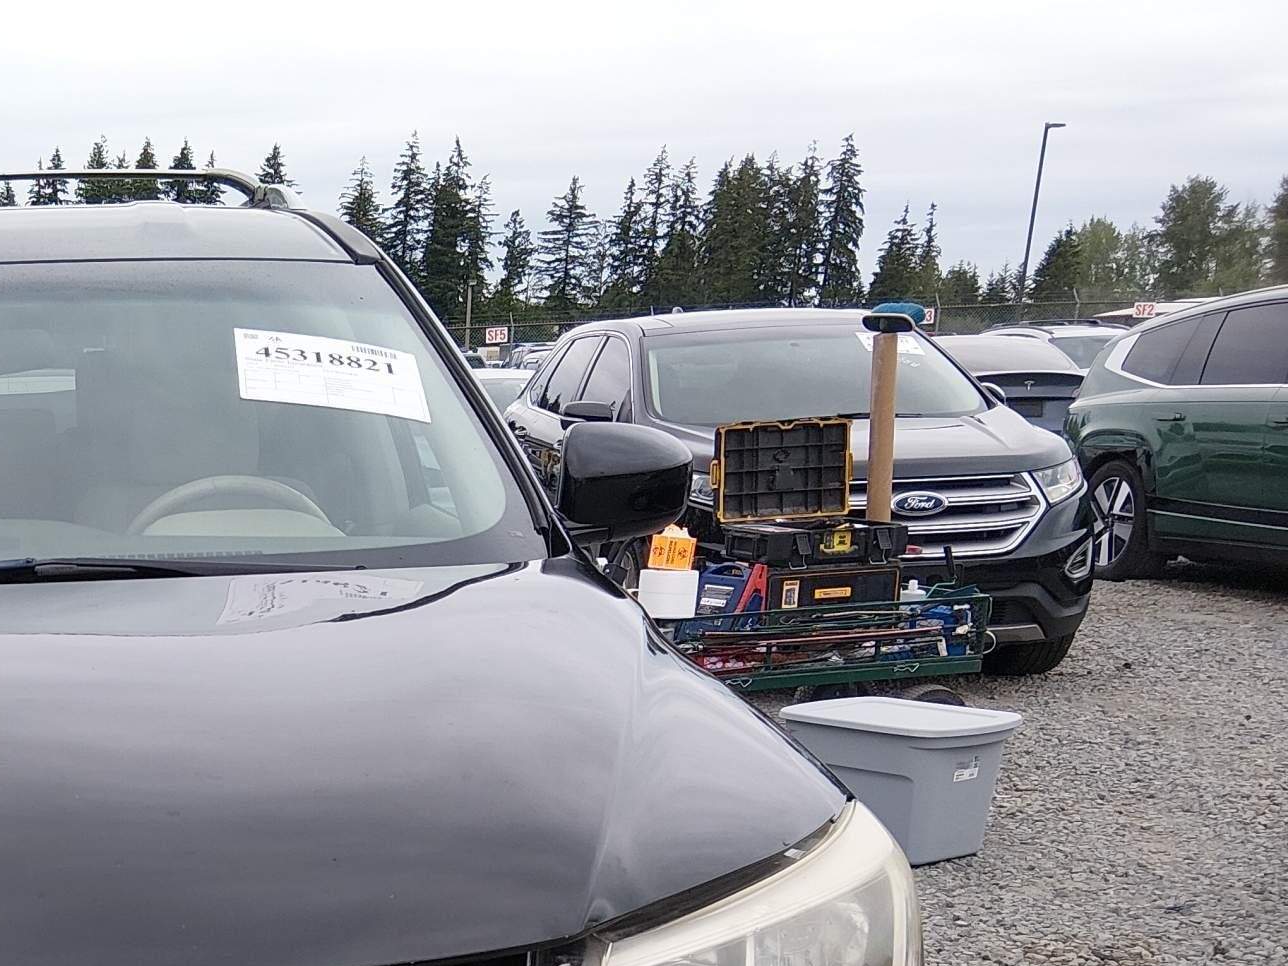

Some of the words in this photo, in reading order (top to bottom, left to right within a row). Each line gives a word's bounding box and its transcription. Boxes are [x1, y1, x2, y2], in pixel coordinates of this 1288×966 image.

[1135, 303, 1154, 316] SF2
[487, 328, 506, 342] SF5
[255, 345, 394, 375] 45318821
[904, 496, 936, 509] Ford
